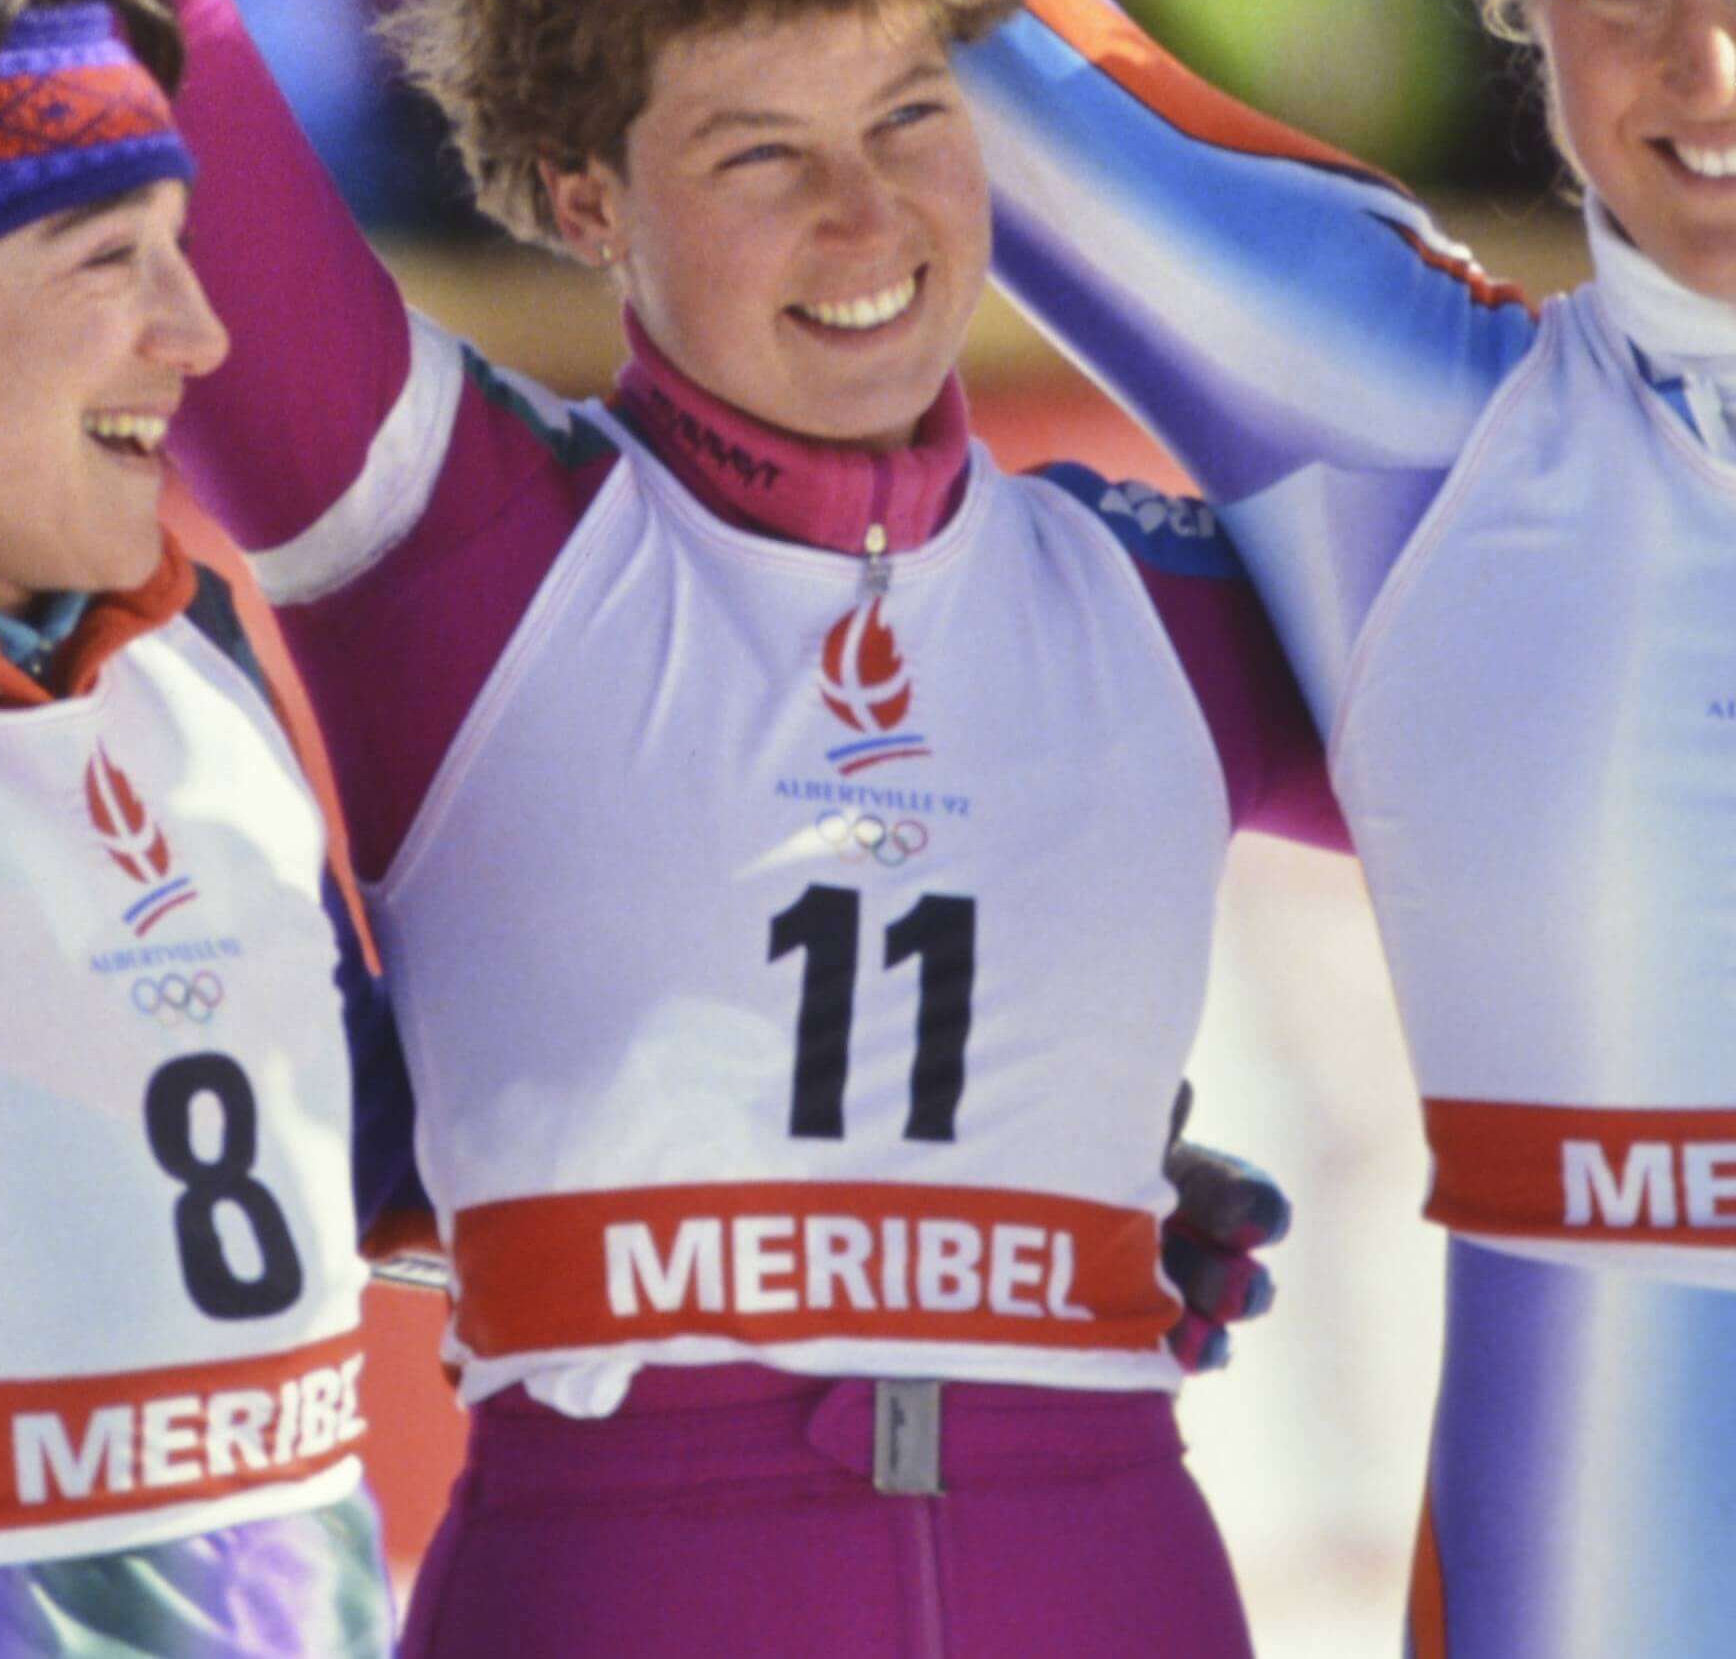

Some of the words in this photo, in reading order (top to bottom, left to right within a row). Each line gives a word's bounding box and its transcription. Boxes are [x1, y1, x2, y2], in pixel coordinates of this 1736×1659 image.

[775, 780, 932, 812] ALBERTVILLE
[767, 882, 977, 1143] 11
[144, 1051, 305, 1322] 8
[603, 1215, 1095, 1322] MERIBEL
[11, 1352, 368, 1507] MERIBE
